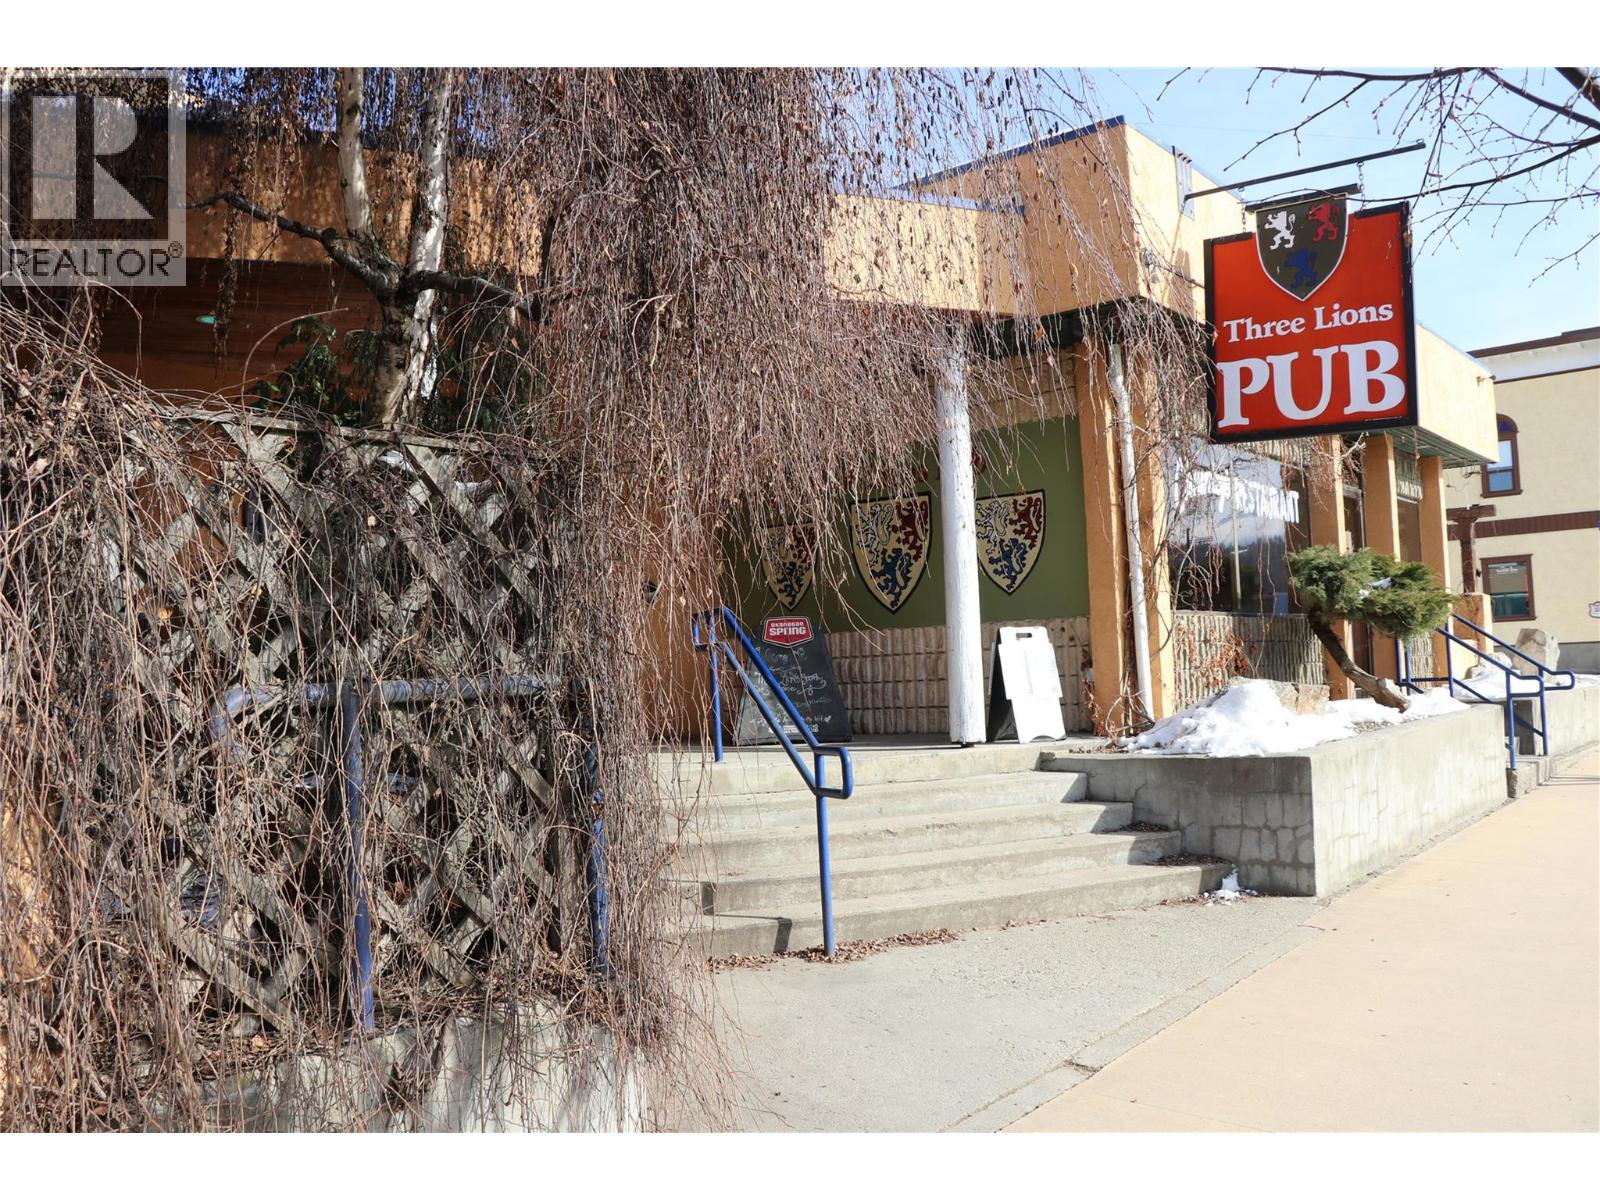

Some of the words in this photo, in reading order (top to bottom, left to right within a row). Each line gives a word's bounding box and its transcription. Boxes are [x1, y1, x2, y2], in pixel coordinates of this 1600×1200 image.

[1223, 317, 1306, 343] Three
[1313, 303, 1394, 331] Lions
[1216, 340, 1406, 428] PUB
